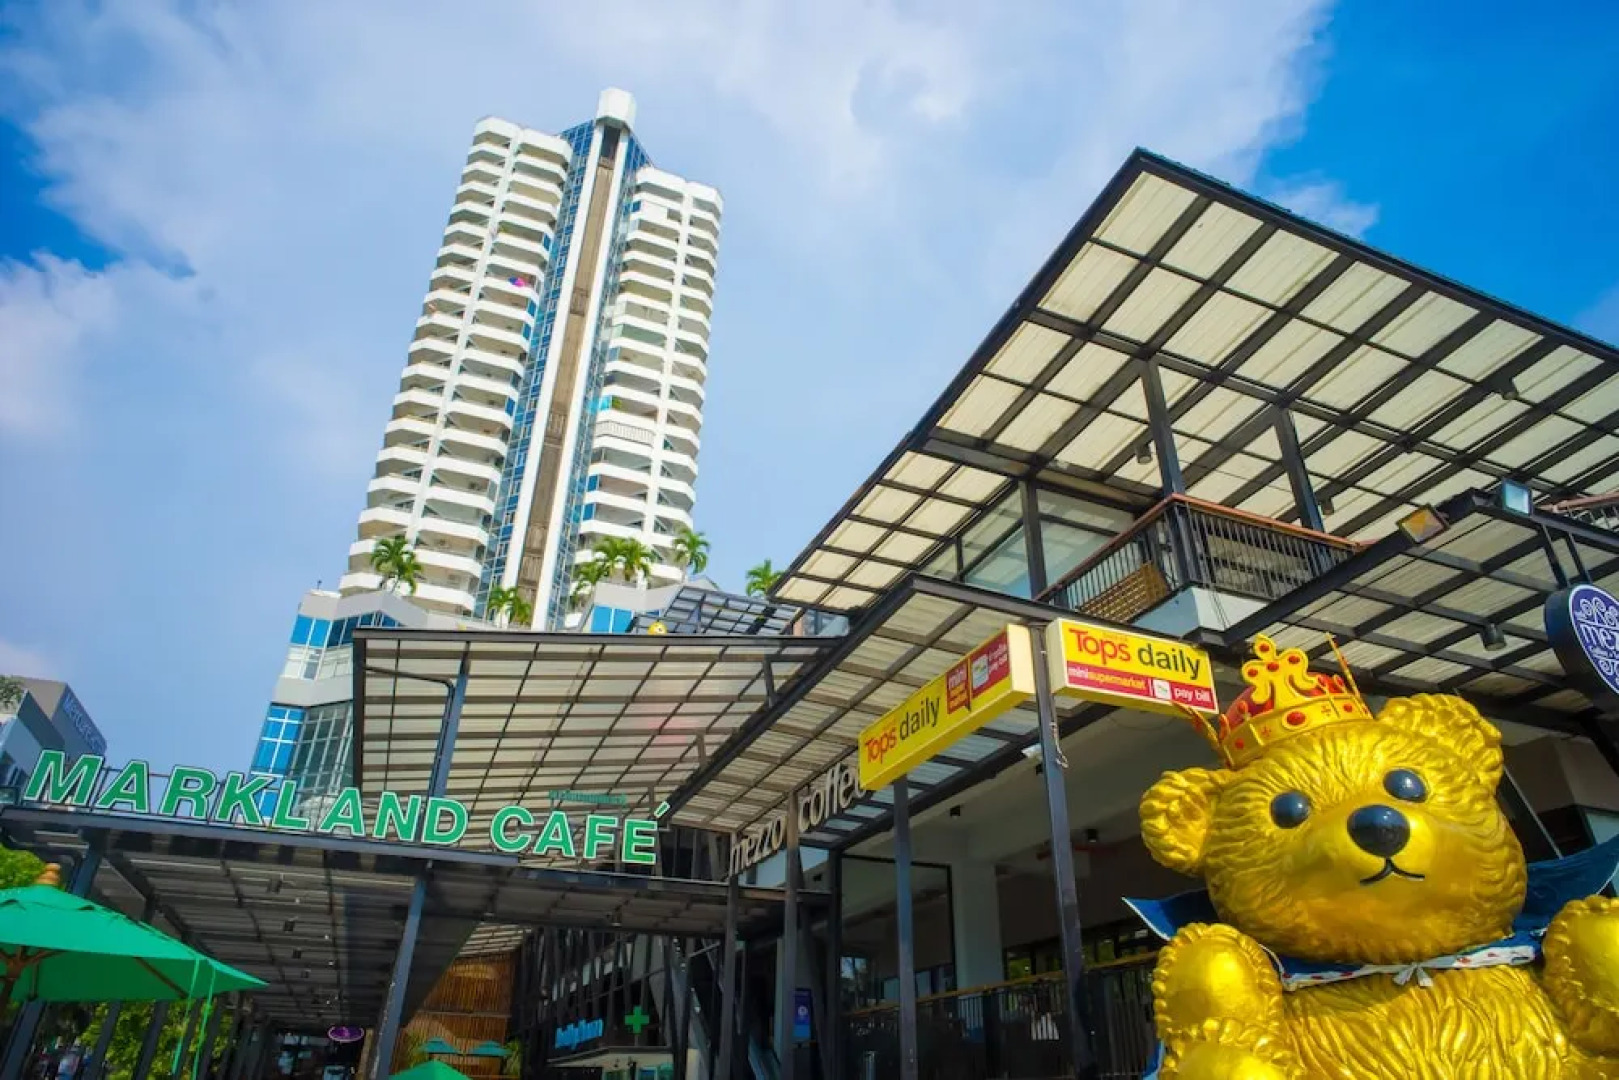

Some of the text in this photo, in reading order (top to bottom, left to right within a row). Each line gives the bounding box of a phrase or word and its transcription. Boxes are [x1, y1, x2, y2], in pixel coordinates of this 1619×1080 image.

[1069, 627, 1200, 681] Tops daily
[1173, 687, 1194, 701] pay
[865, 697, 940, 765] Tops daily
[23, 749, 671, 864] MARKLAND CAFÉ
[729, 815, 787, 878] mezzo
